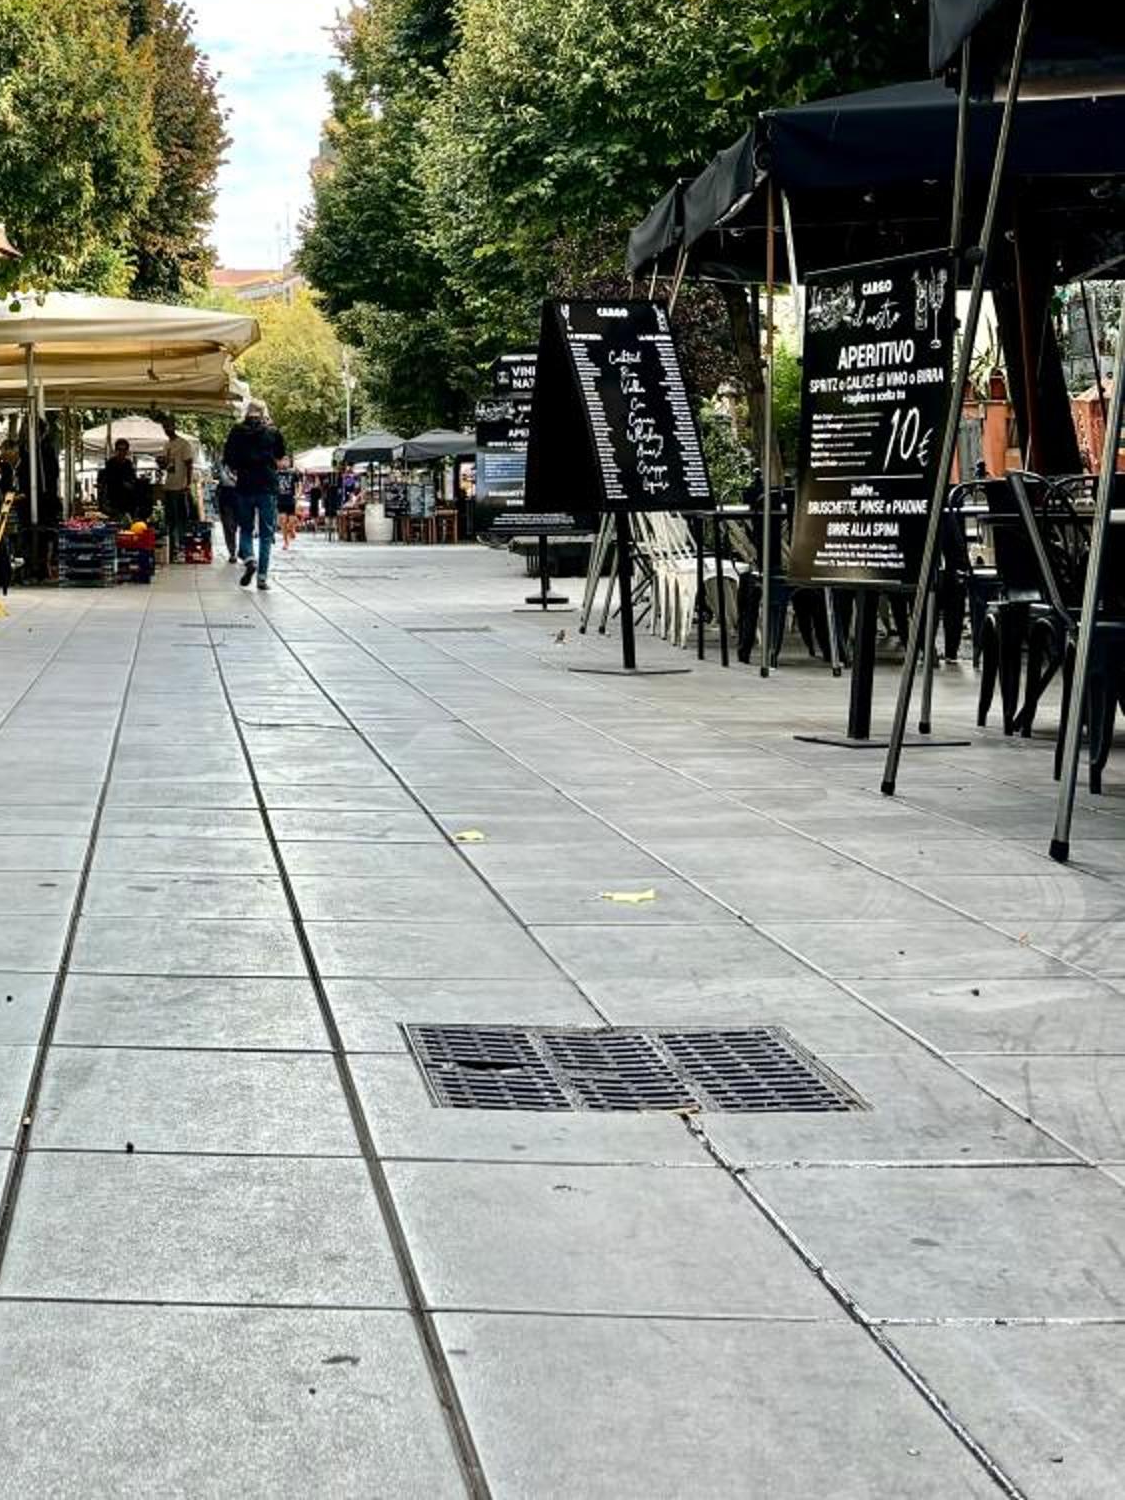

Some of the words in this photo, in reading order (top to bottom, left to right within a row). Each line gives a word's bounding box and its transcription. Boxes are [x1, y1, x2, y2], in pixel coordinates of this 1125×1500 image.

[861, 279, 893, 296] CARGO
[596, 307, 628, 318] CARGO
[837, 339, 915, 371] APERITIVO
[511, 365, 536, 377] VINI
[809, 377, 838, 393] SPRITZ
[846, 373, 876, 390] CALICE
[886, 370, 908, 387] VINO
[908, 373, 916, 385] o
[916, 367, 944, 384] BIRRA
[892, 500, 928, 515] PIADINE
[826, 522, 850, 537] BIRRE
[850, 522, 872, 537] ALLA
[872, 522, 900, 537] SPINA
